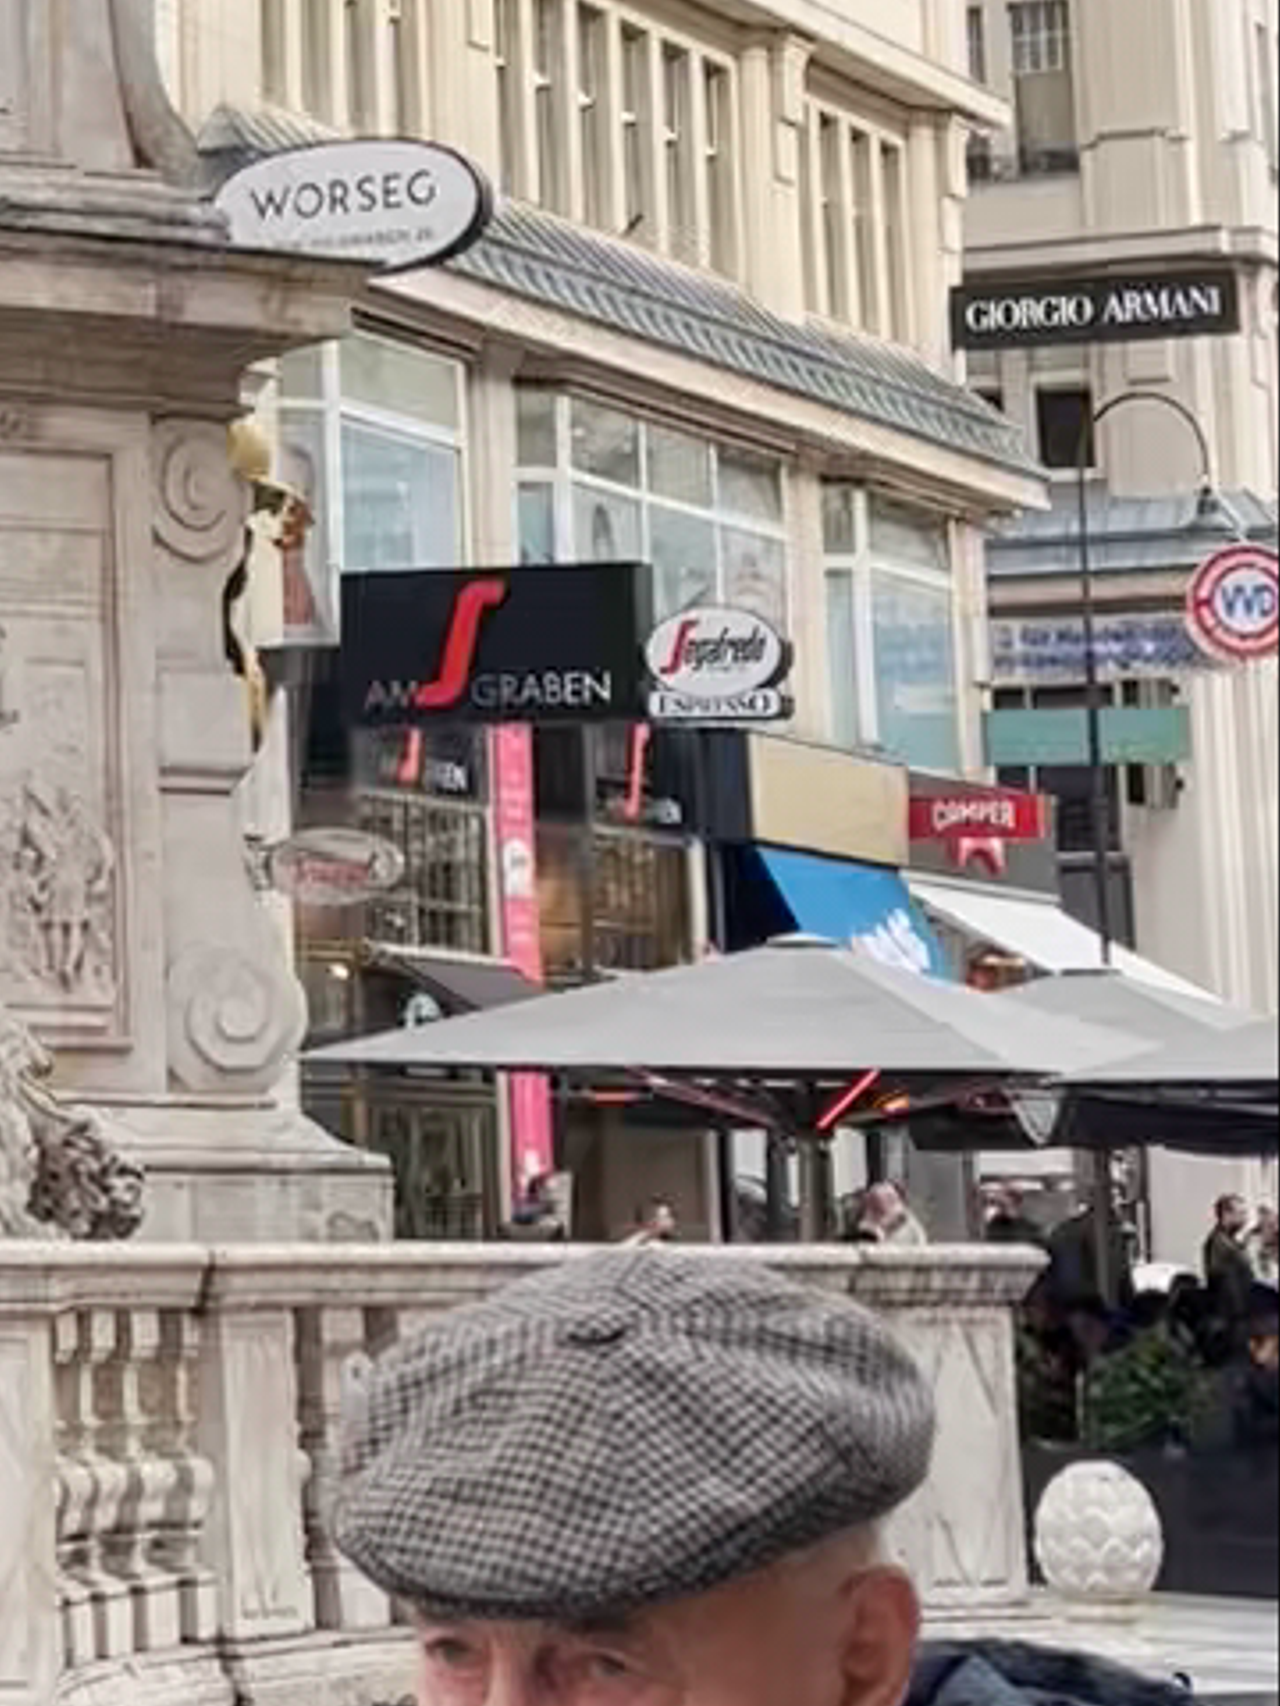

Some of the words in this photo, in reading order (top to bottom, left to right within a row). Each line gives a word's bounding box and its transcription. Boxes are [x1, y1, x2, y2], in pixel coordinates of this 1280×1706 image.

[250, 168, 437, 220] WORSEG
[965, 295, 1094, 332] GIORGIO
[1102, 285, 1220, 324] ARMANI
[659, 620, 767, 671] Segafredo
[364, 680, 419, 710] AM
[471, 670, 612, 707] GRABEN
[931, 799, 1016, 831] CAMPER
